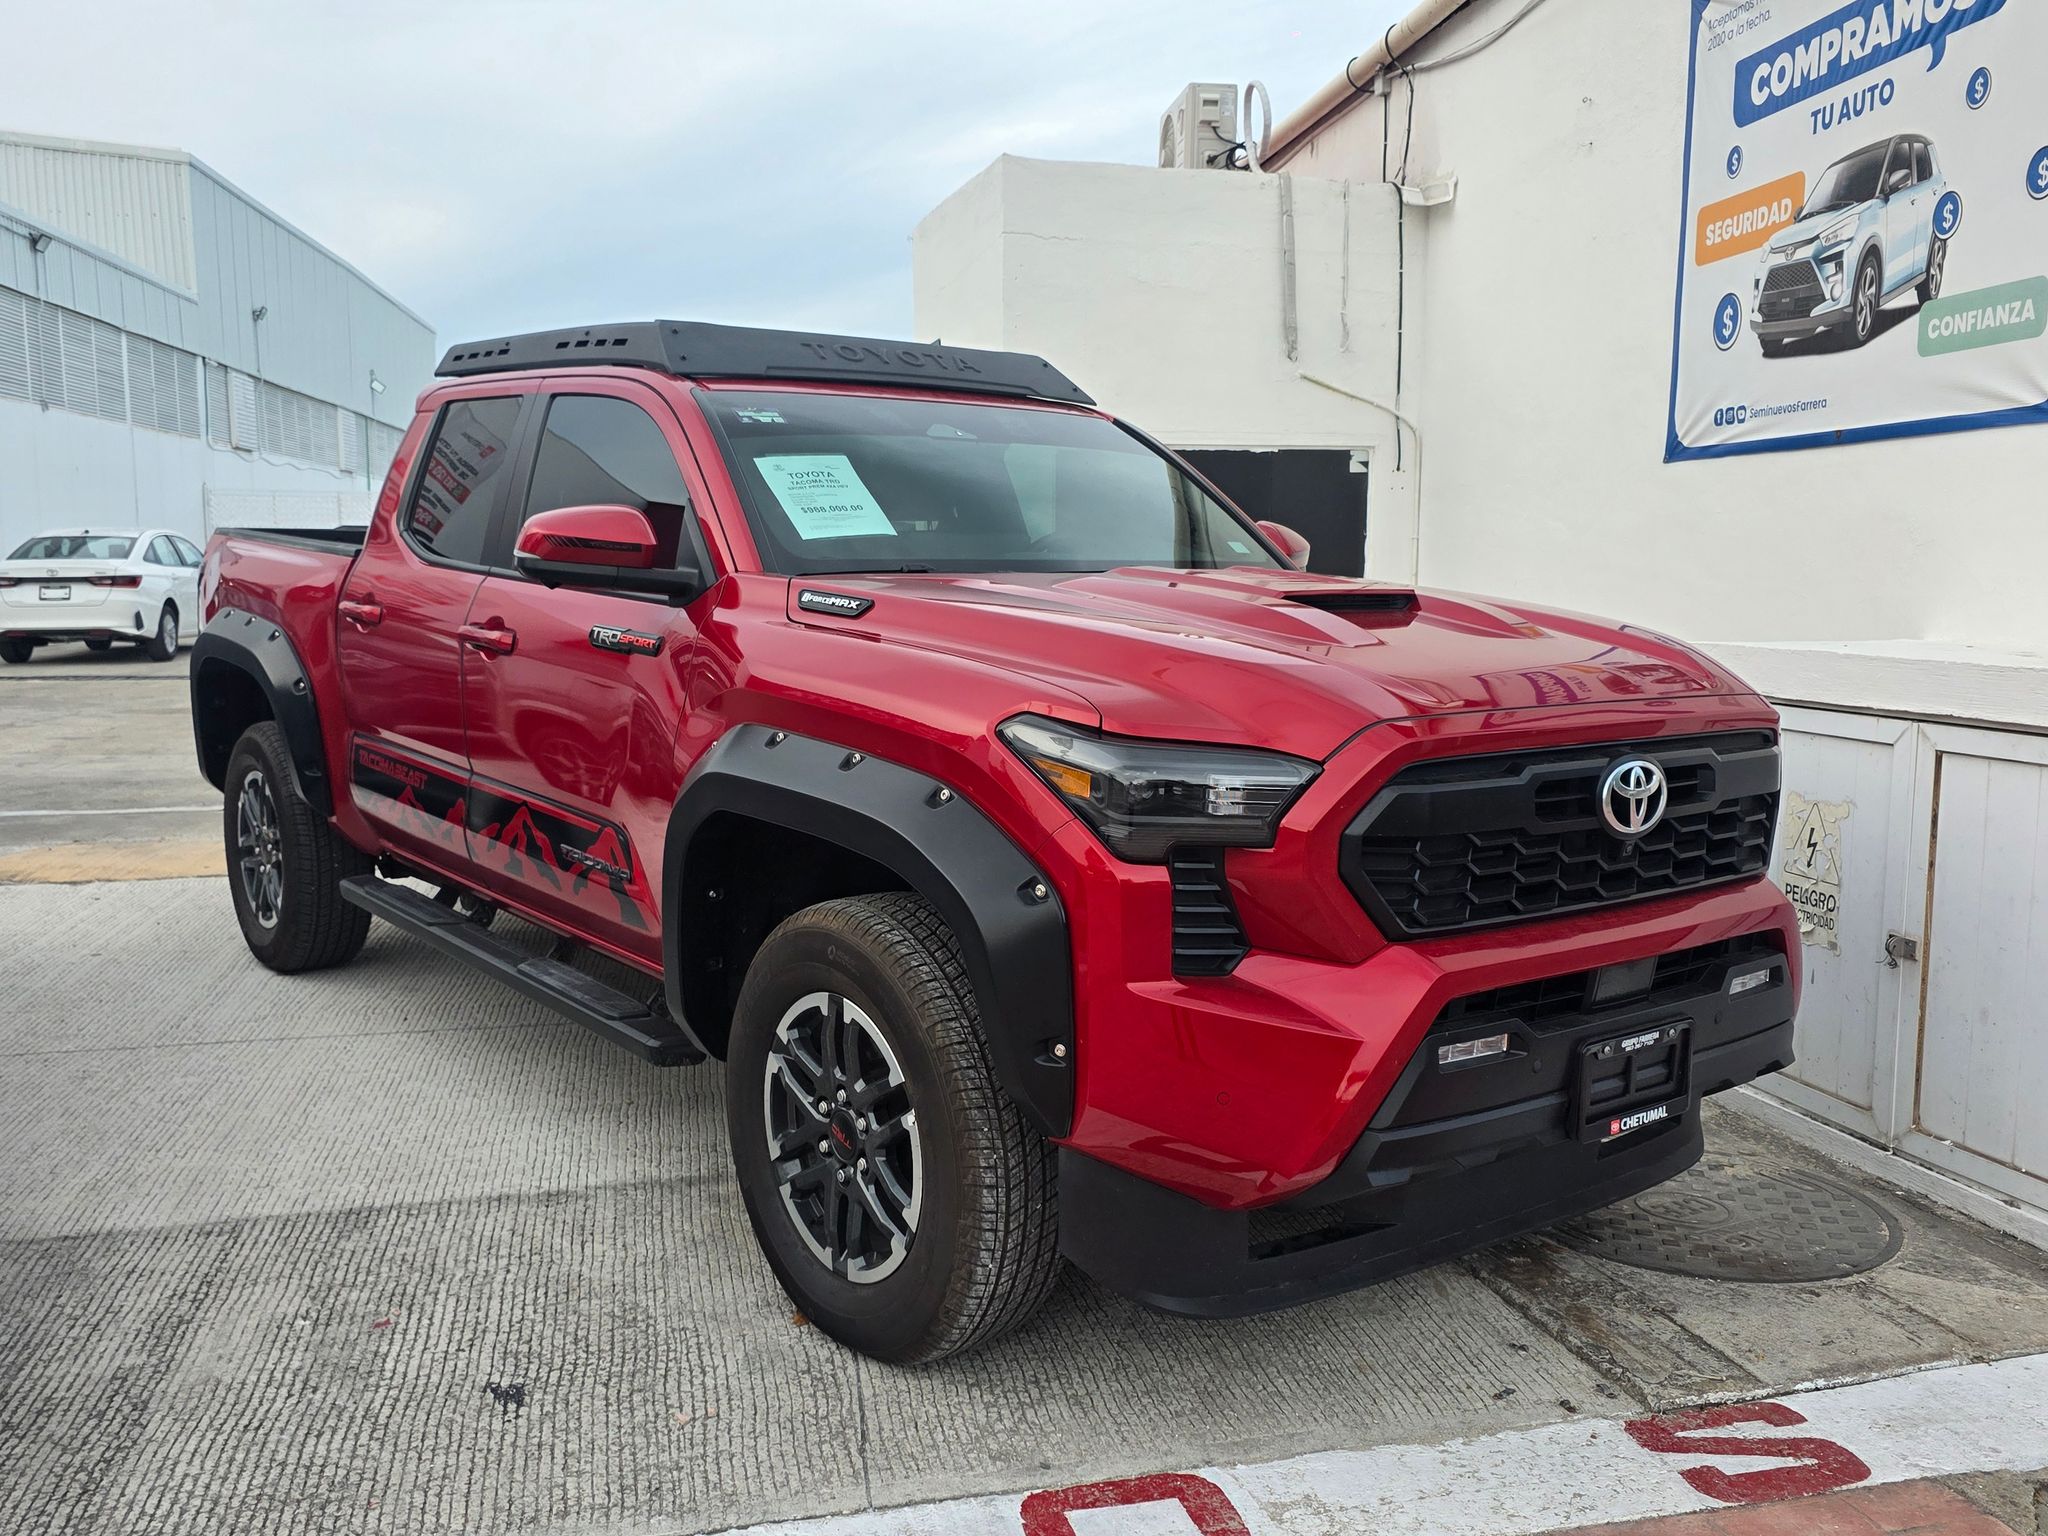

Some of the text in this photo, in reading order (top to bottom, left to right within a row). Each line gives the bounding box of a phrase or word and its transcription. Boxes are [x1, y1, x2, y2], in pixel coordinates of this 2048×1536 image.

[1708, 31, 1726, 51] 2020
[1750, 0, 1976, 106] COMPRAMO
[1810, 78, 1895, 135] TU AUTO
[1705, 198, 1792, 247] SEGURIDAD
[1927, 298, 2036, 339] CONFIANZA
[800, 342, 982, 373] TOYOTA
[1749, 398, 1828, 419] SeminuevosFarrera
[787, 470, 836, 480] TOYOTA
[619, 633, 657, 649] SPORT
[1785, 883, 1836, 913] PELIGRO
[1620, 1105, 1668, 1130] CHETUMAL
